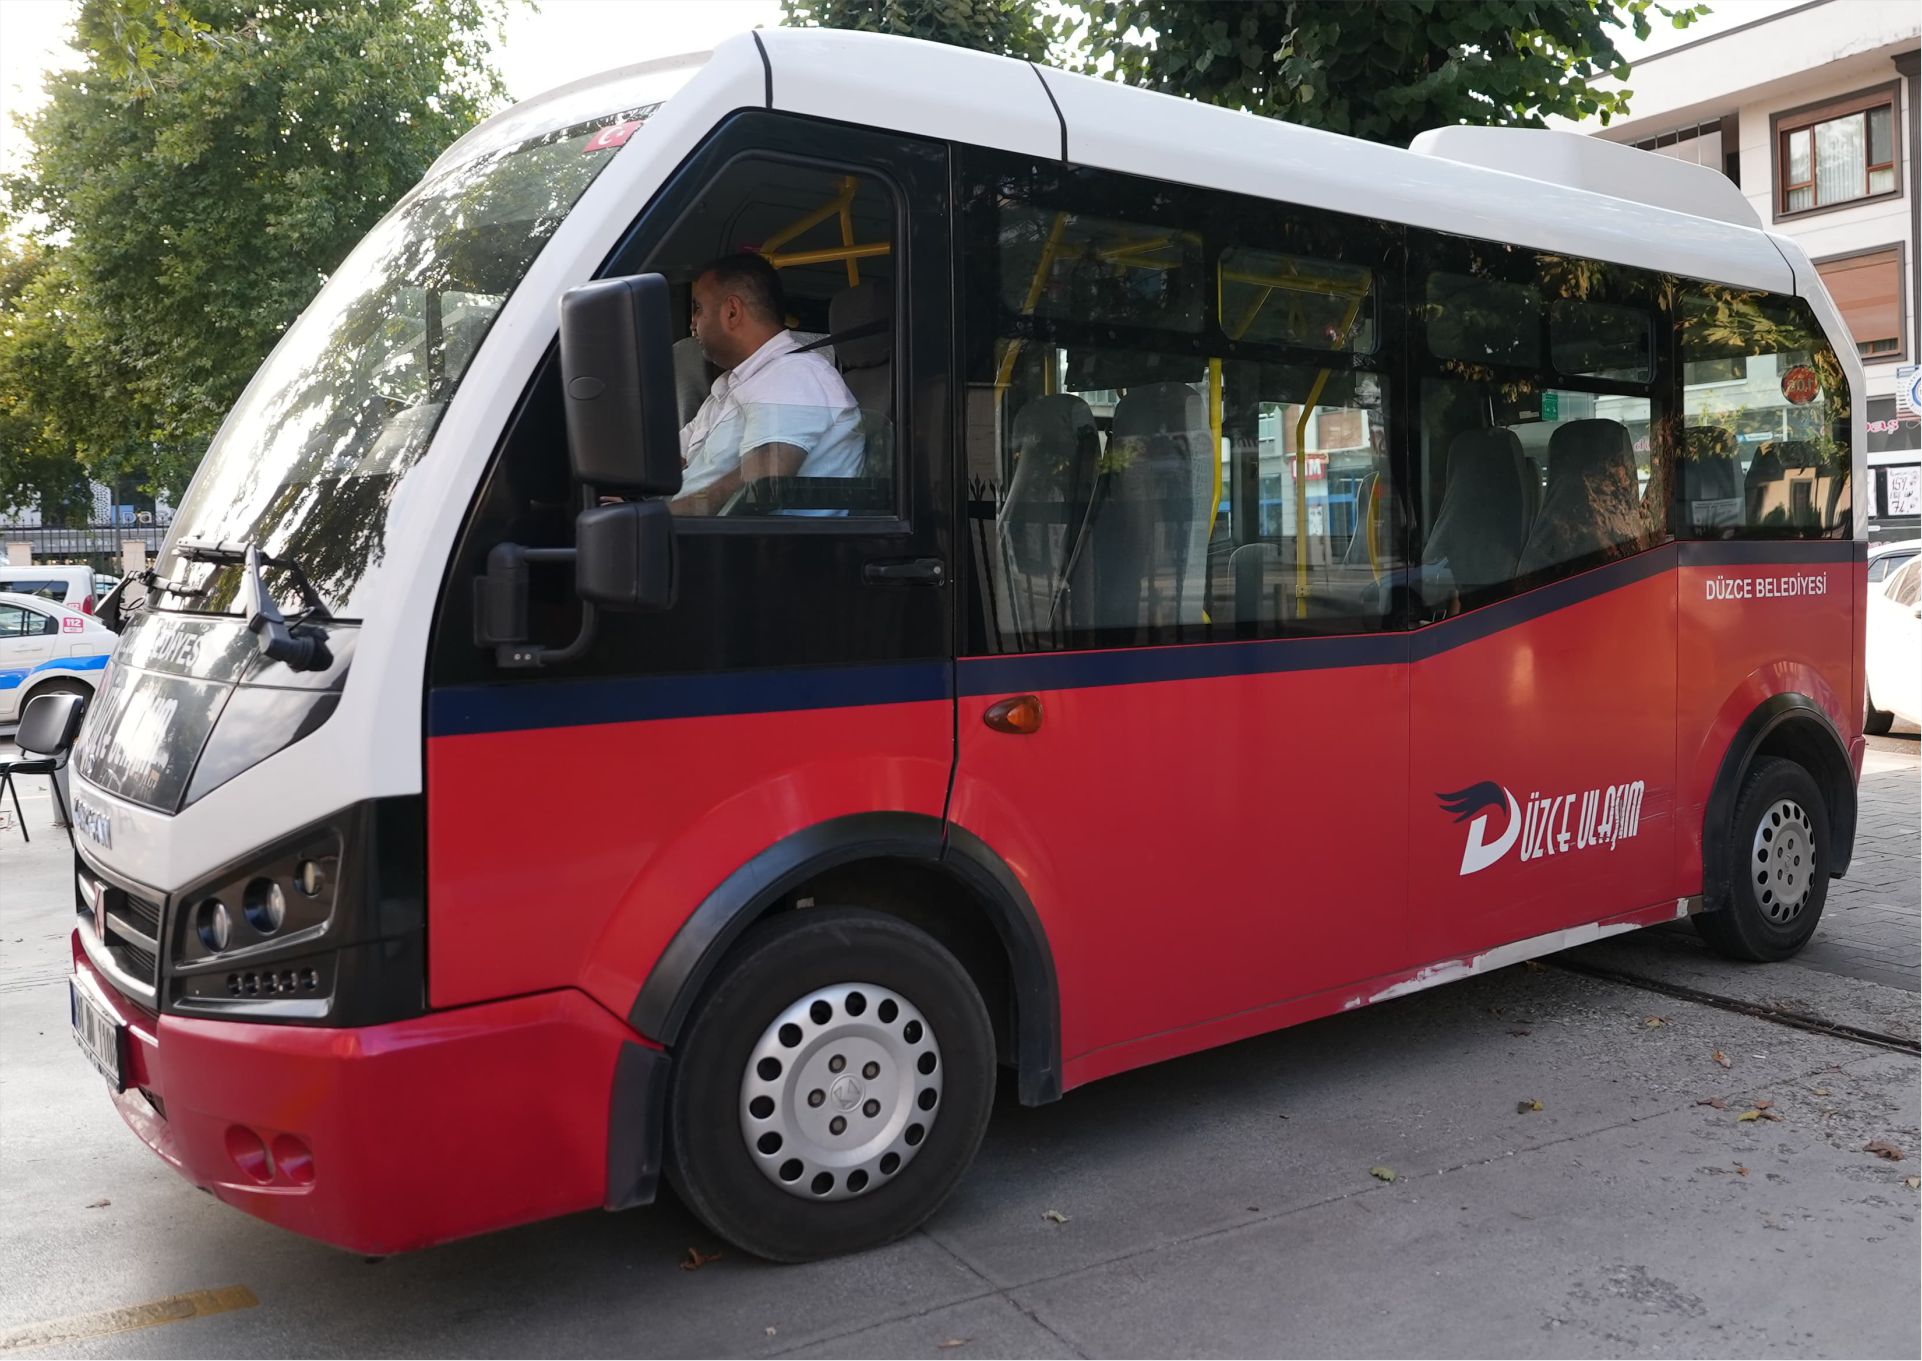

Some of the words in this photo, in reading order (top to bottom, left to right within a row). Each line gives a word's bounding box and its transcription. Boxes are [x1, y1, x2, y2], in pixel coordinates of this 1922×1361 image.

[1706, 575, 1752, 600] DÜZCE
[1756, 571, 1827, 598] BELEDİYESİ
[66, 618, 82, 627] 112
[1577, 780, 1645, 851] ULAŞIM
